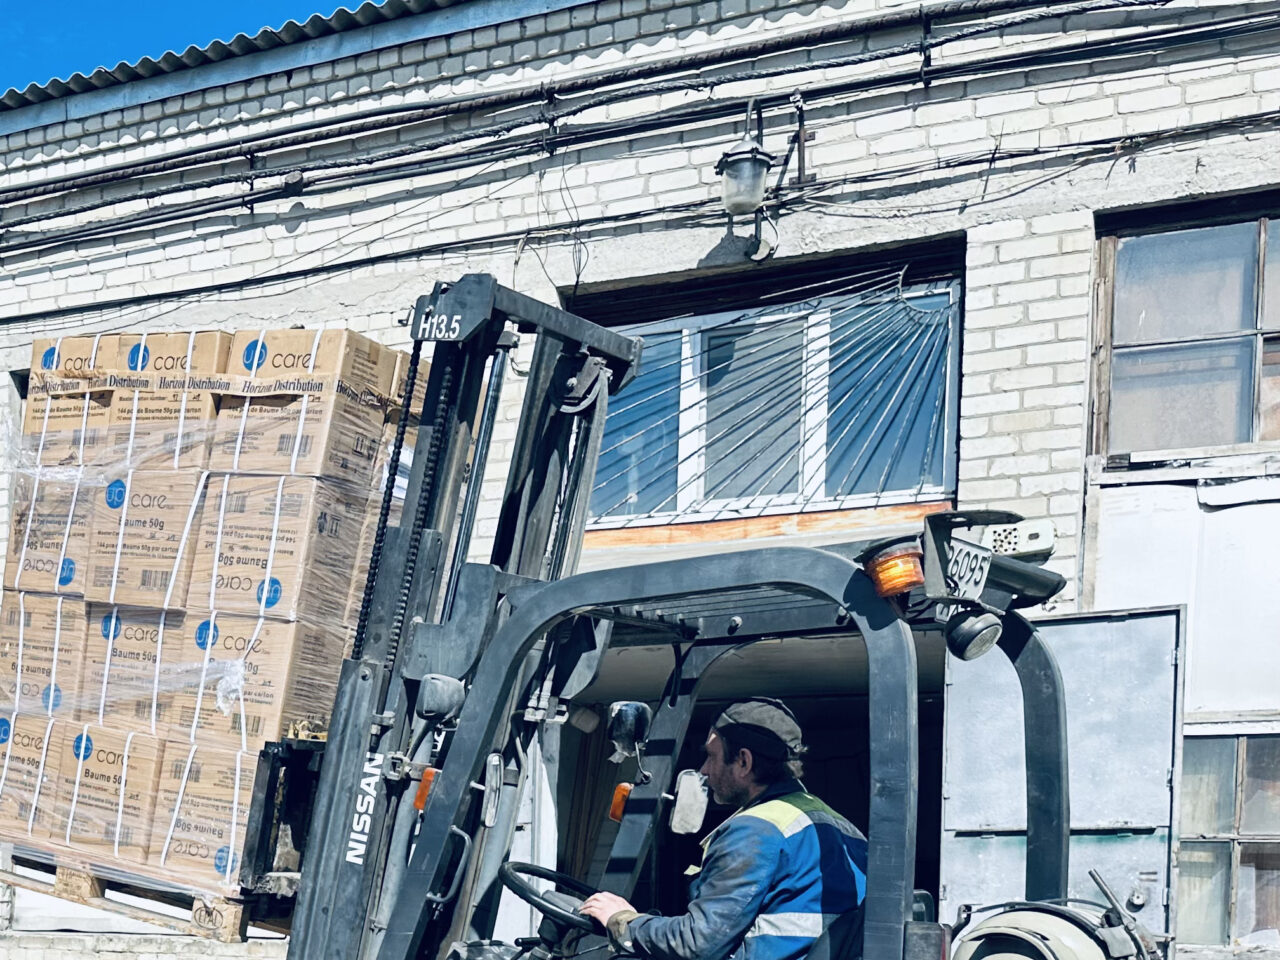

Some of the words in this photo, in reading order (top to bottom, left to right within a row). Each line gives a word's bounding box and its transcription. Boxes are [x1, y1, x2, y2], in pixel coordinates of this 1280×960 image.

[418, 314, 462, 339] H13.5
[272, 353, 312, 369] care
[109, 374, 150, 389] Distribution
[187, 376, 231, 391] Distribution
[241, 379, 274, 394] Horizon
[273, 377, 325, 393] Distribution
[131, 493, 167, 509] care
[149, 517, 165, 530] 50g
[23, 559, 54, 573] care
[218, 553, 234, 566] 50g
[236, 556, 268, 569] Baume
[215, 575, 253, 591] care
[124, 627, 159, 643] care
[111, 648, 140, 661] Baume
[142, 650, 158, 664] 50g
[26, 665, 52, 677] Baume
[9, 682, 40, 697] cae
[13, 732, 43, 750] care
[1, 751, 25, 764] Bume
[26, 757, 40, 769] 50g
[84, 768, 111, 783] Baume
[346, 751, 384, 866] NISSAN
[175, 818, 192, 833] 50g
[193, 824, 224, 839] Baume
[173, 840, 209, 859] care
